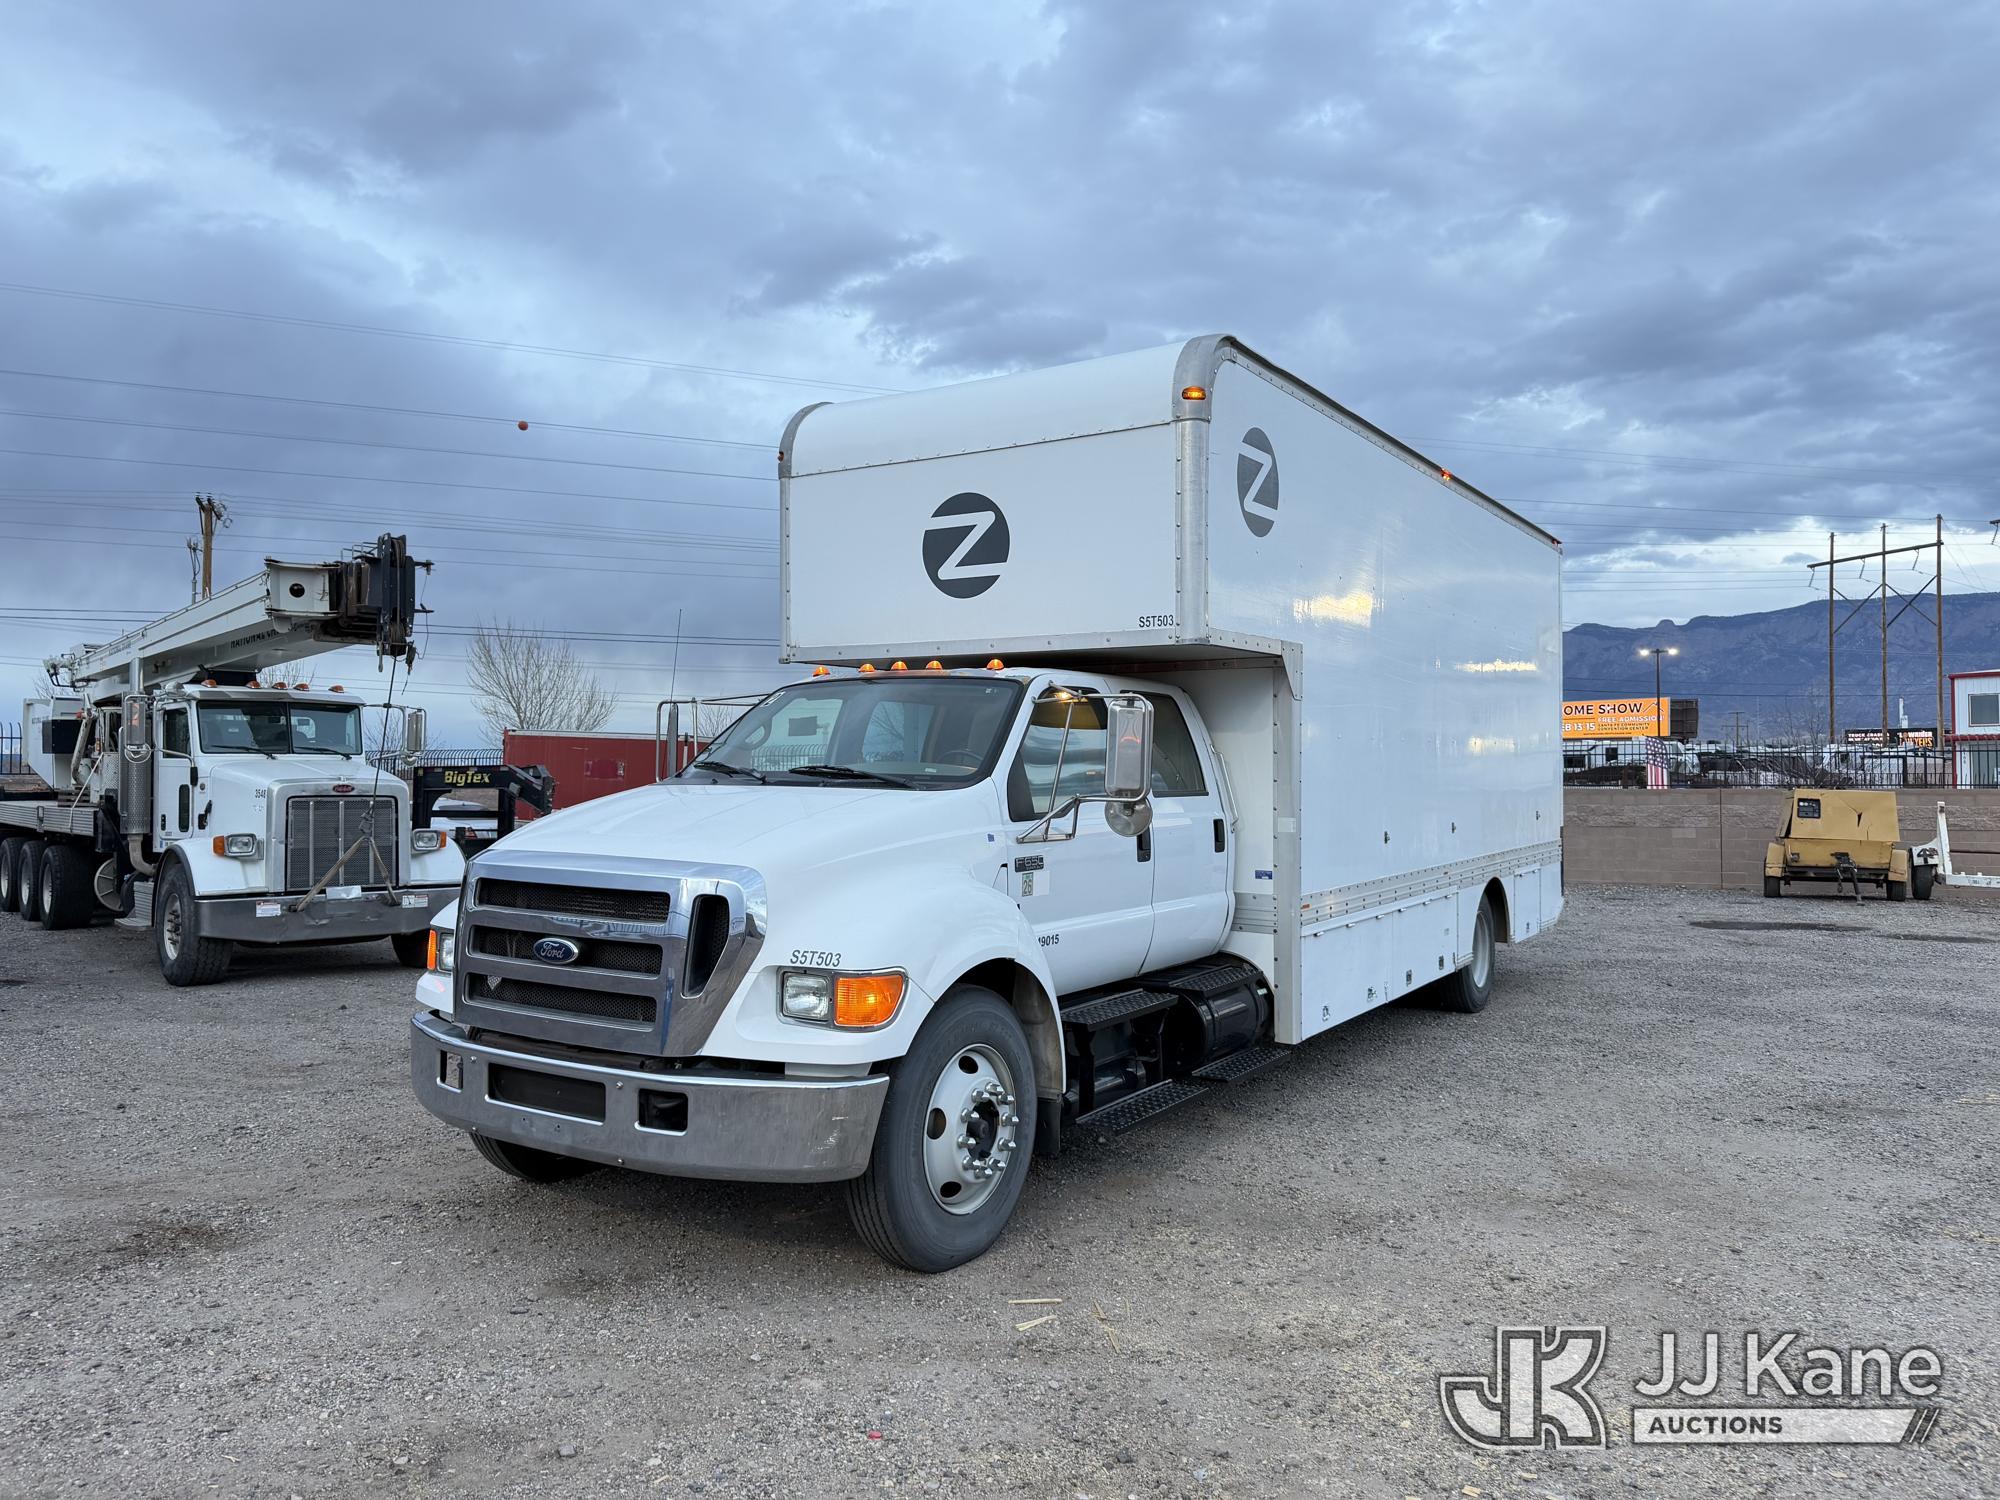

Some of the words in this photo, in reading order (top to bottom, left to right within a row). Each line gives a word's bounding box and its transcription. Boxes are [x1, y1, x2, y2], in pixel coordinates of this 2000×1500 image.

[1138, 614, 1174, 628] S5T503
[1563, 704, 1594, 716] OME
[1598, 702, 1643, 714] SHOW
[444, 770, 491, 787] BigTex
[540, 941, 566, 959] Ford
[790, 949, 842, 967] S5T503
